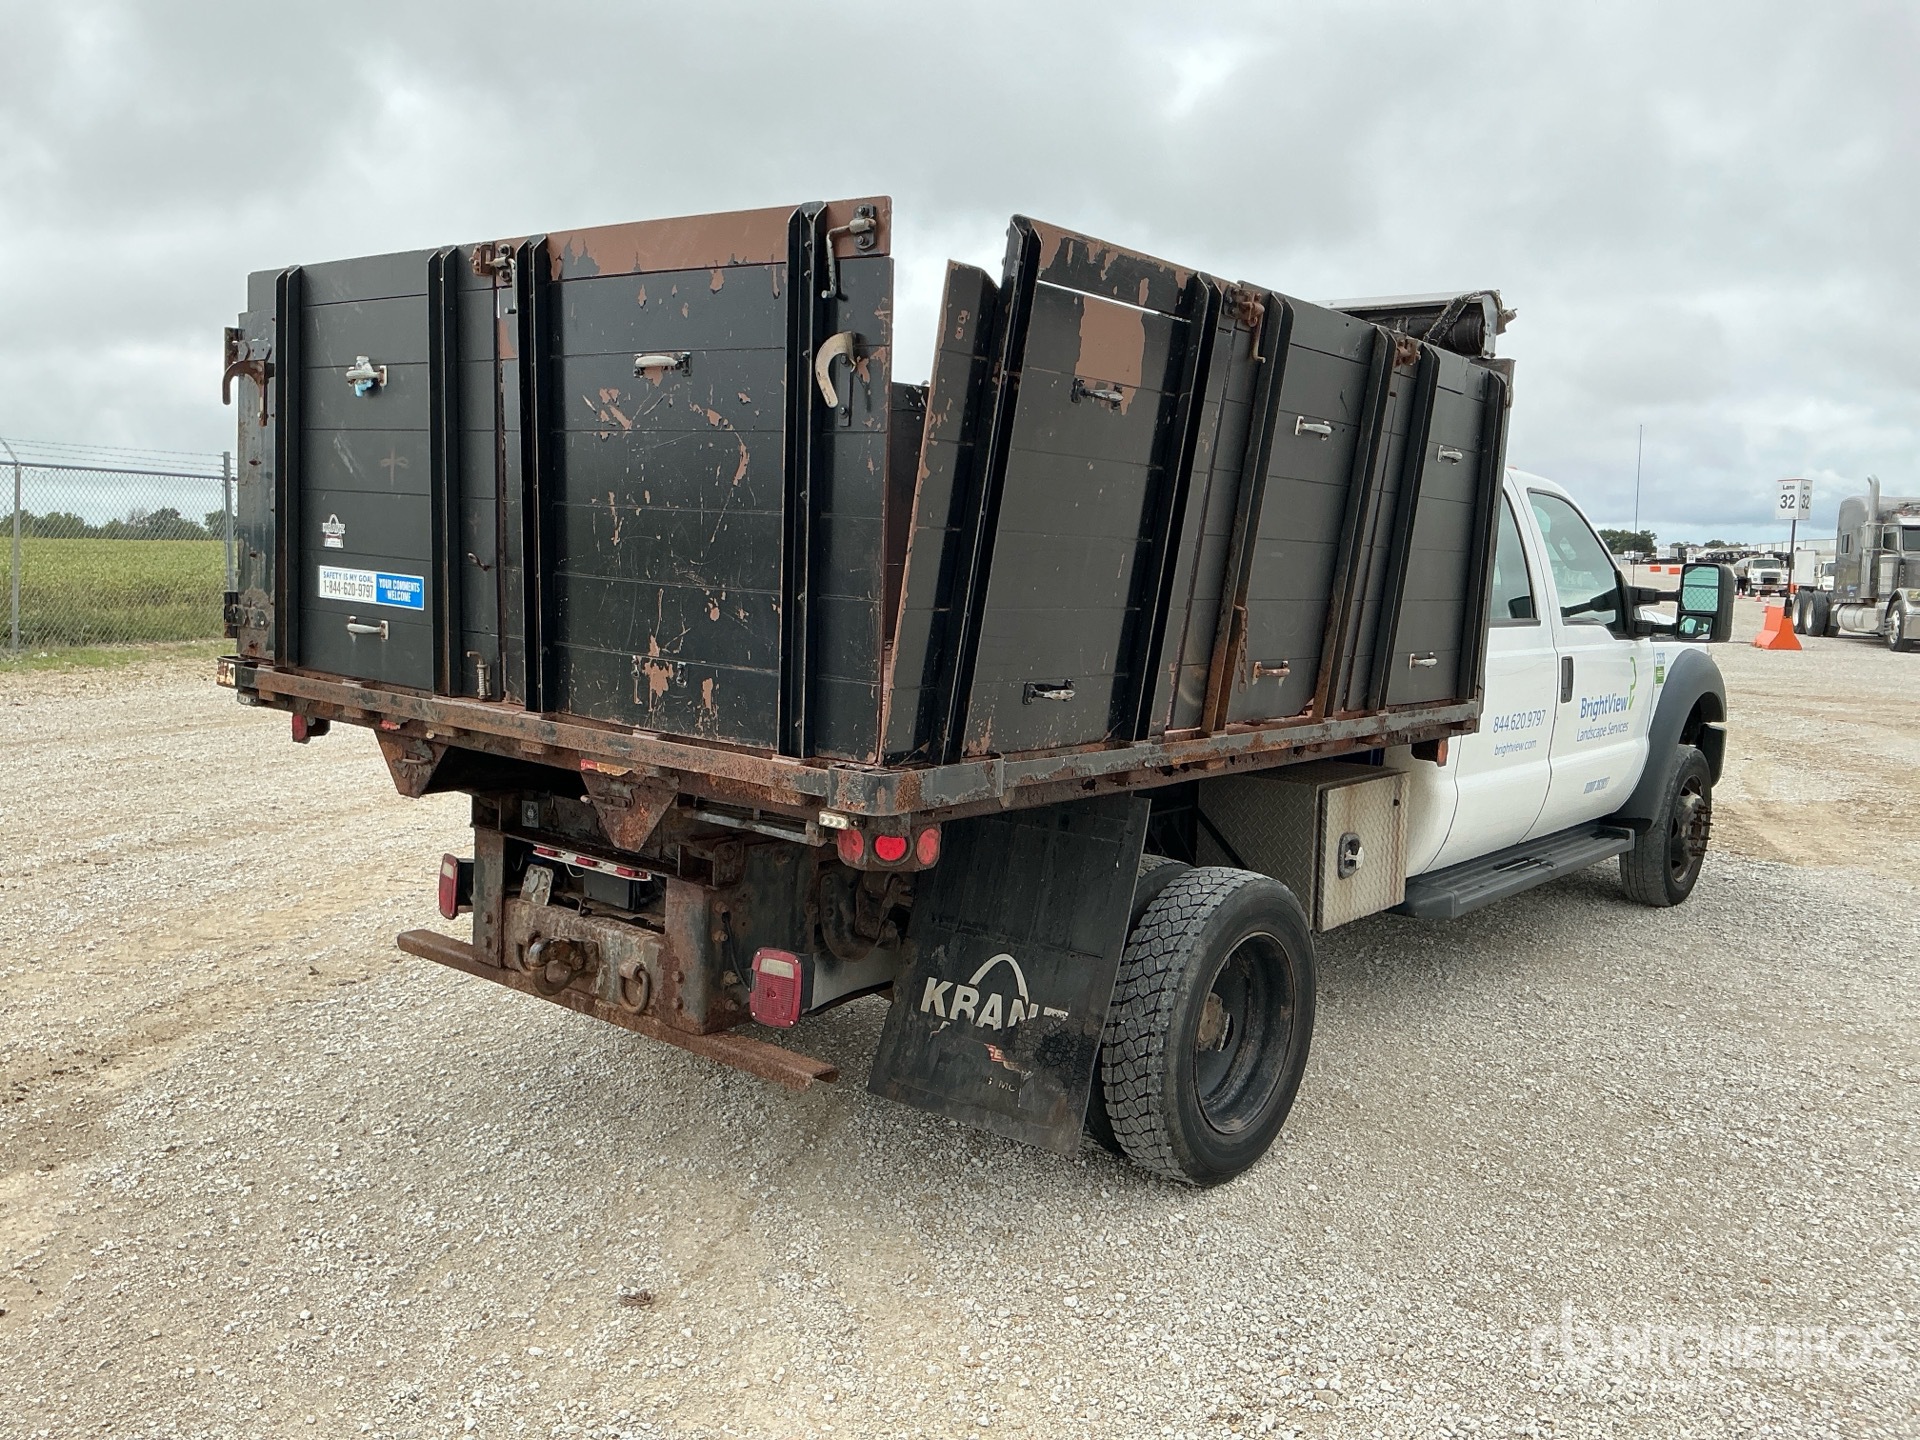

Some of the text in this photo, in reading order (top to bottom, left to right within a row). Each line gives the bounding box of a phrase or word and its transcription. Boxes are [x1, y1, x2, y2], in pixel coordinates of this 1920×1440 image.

[1779, 493, 1796, 509] 32
[1801, 493, 1810, 510] 32
[323, 570, 342, 580] SAFETY
[349, 573, 358, 582] MY
[358, 575, 374, 583] GOAL
[323, 580, 374, 599] 1-844-620-9797
[378, 578, 421, 593] YOUR COMMENTS
[386, 590, 412, 603] WELCOME
[1580, 692, 1630, 722] BrightView
[1493, 709, 1546, 734] 844.620.9797
[1576, 721, 1630, 742] Landscape Services
